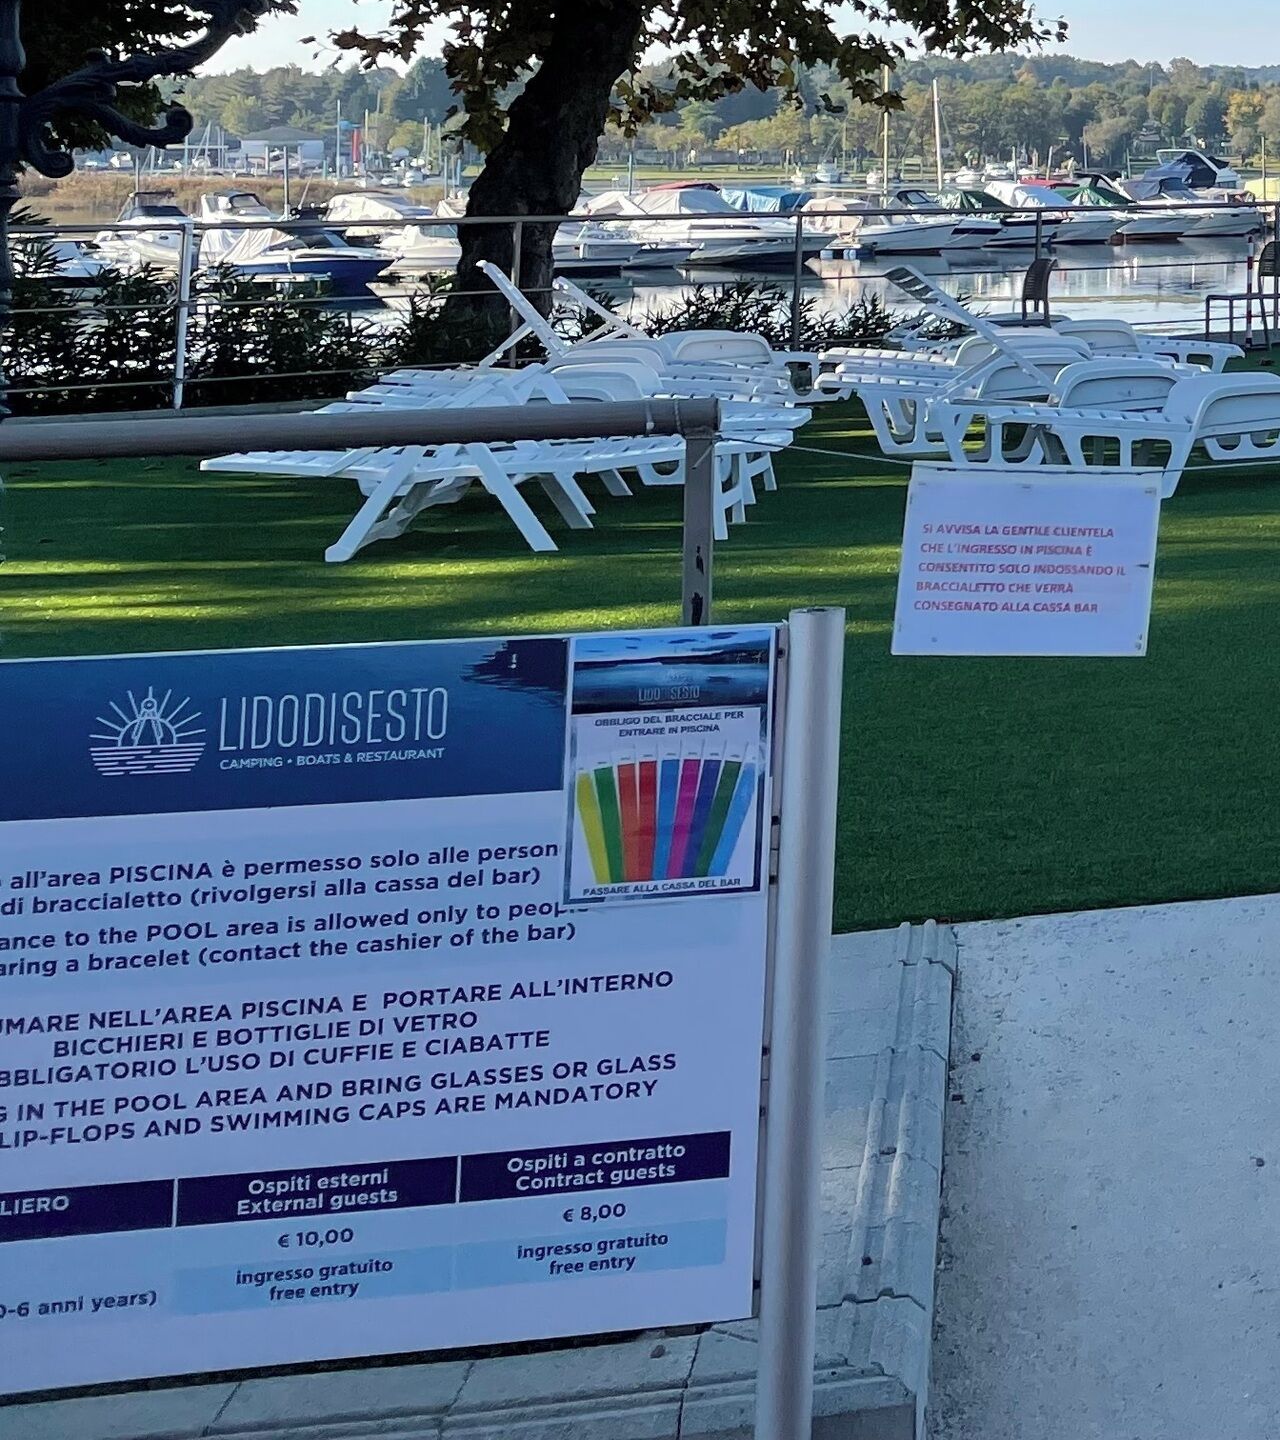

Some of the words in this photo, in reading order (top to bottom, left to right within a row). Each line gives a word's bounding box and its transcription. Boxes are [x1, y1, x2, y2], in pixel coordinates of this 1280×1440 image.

[923, 524, 932, 534] SI
[937, 524, 980, 535] AVVISA
[985, 524, 999, 535] LA
[1002, 525, 1050, 536] GENTILE
[1053, 526, 1114, 538] CLIENTELA
[920, 543, 944, 554] CHE
[947, 543, 1017, 555] L'INGRESSO
[1020, 545, 1033, 555] IN
[1036, 545, 1082, 556] PISCINA
[918, 562, 995, 574] CONSENTITO
[998, 563, 1030, 574] SOLO
[1033, 564, 1113, 576] INDOSSANDO
[1116, 565, 1126, 576] IL
[916, 581, 1005, 593] BRACCIALETTO
[1009, 582, 1031, 593] CHE
[1035, 581, 1074, 594] VERRÀ
[914, 600, 998, 612] CONSEGNATO
[1001, 601, 1030, 612] ALLA
[1033, 602, 1071, 613] CASSA
[1074, 602, 1098, 614] BAR
[218, 687, 448, 752] LIDODISESTO
[594, 717, 640, 727] OBBLIGO
[643, 715, 662, 724] DEL
[665, 712, 721, 723] BRACCIALE
[724, 710, 744, 719] PER
[619, 727, 665, 737] ENTRARE
[668, 726, 678, 735] IN
[680, 724, 720, 734] PISCINA
[219, 755, 283, 770] CAMPING
[296, 752, 341, 766] BOATS
[344, 752, 353, 764] &
[356, 747, 446, 763] RESTAURANT
[10, 870, 101, 889] all'area
[109, 862, 213, 884] PISCINA
[222, 860, 236, 878] è
[244, 856, 362, 880] permesso
[370, 849, 420, 868] solo
[428, 847, 470, 865] alle
[478, 843, 559, 865] person
[1, 897, 24, 915] di
[32, 889, 182, 914] braccialetto
[190, 880, 316, 906] (rivolgersi
[324, 878, 366, 897] alla
[375, 874, 439, 893] cassa
[447, 869, 484, 889] del
[492, 866, 541, 885] bar)
[583, 885, 630, 897] PASSARE
[632, 883, 660, 894] ALLA
[662, 880, 697, 892] CASSA
[698, 879, 717, 889] DEL
[719, 878, 741, 888] BAR
[65, 930, 90, 947] to
[99, 927, 138, 944] the
[147, 922, 218, 942] POOL
[226, 920, 279, 937] area
[287, 915, 305, 933] is
[314, 908, 409, 931] allowed
[417, 904, 468, 925] only
[477, 902, 500, 920] to
[509, 901, 588, 921] peop
[66, 958, 80, 973] a
[89, 948, 189, 971] bracelet
[199, 940, 301, 967] (contact
[309, 938, 348, 957] the
[357, 933, 442, 953] cashier
[450, 929, 475, 947] of
[482, 926, 519, 945] the
[527, 922, 576, 942] bar)
[0, 1013, 80, 1037] MARE
[89, 1004, 233, 1030] NELL'AREA
[242, 996, 343, 1020] PISCINA
[353, 993, 368, 1011] E
[383, 984, 502, 1009] PORTARE
[510, 970, 674, 1000] ALL'INTERNO
[54, 1032, 183, 1058] BICCHIERI
[193, 1031, 208, 1049] E
[217, 1021, 350, 1047] BOTTIGLIE
[359, 1017, 384, 1036] DI
[393, 1011, 478, 1034] VETRO
[186, 1052, 260, 1074] L'USO
[270, 1050, 294, 1069] DI
[303, 1042, 394, 1065] CUFFIE
[402, 1040, 417, 1058] E
[425, 1030, 550, 1056] CIABATTE
[17, 1103, 44, 1122] IN
[54, 1098, 105, 1119] THE
[114, 1092, 187, 1115] POOL
[195, 1086, 267, 1109] AREA
[276, 1080, 333, 1103] AND
[342, 1074, 422, 1098] BRING
[430, 1064, 544, 1090] GLASSES
[552, 1060, 588, 1079] OR
[596, 1053, 677, 1077] GLASS
[144, 1116, 201, 1138] AND
[210, 1106, 350, 1133] SWIMMING
[358, 1099, 426, 1122] CAPS
[435, 1094, 486, 1115] ARE
[494, 1079, 658, 1110] MANDATORY
[507, 1152, 567, 1174] Ospiti
[573, 1152, 585, 1166] a
[591, 1144, 686, 1165] contratto
[248, 1175, 311, 1197] Ospiti
[317, 1169, 389, 1190] esterni
[516, 1169, 604, 1191] Contract
[610, 1163, 676, 1185] guests
[0, 1195, 70, 1217] LIERO
[236, 1193, 323, 1216] External
[330, 1188, 398, 1210] guests
[563, 1208, 574, 1223] €
[580, 1203, 626, 1224] 8,00
[278, 1233, 289, 1248] €
[296, 1227, 354, 1250] 10,00
[517, 1241, 593, 1262] ingresso
[597, 1232, 669, 1255] gratuito
[236, 1265, 315, 1287] ingresso
[319, 1259, 393, 1282] gratuito
[550, 1259, 584, 1276] free
[588, 1255, 637, 1274] entry
[38, 1295, 84, 1314] anni
[91, 1289, 157, 1313] years)
[269, 1285, 306, 1302] free
[310, 1280, 360, 1301] entry
